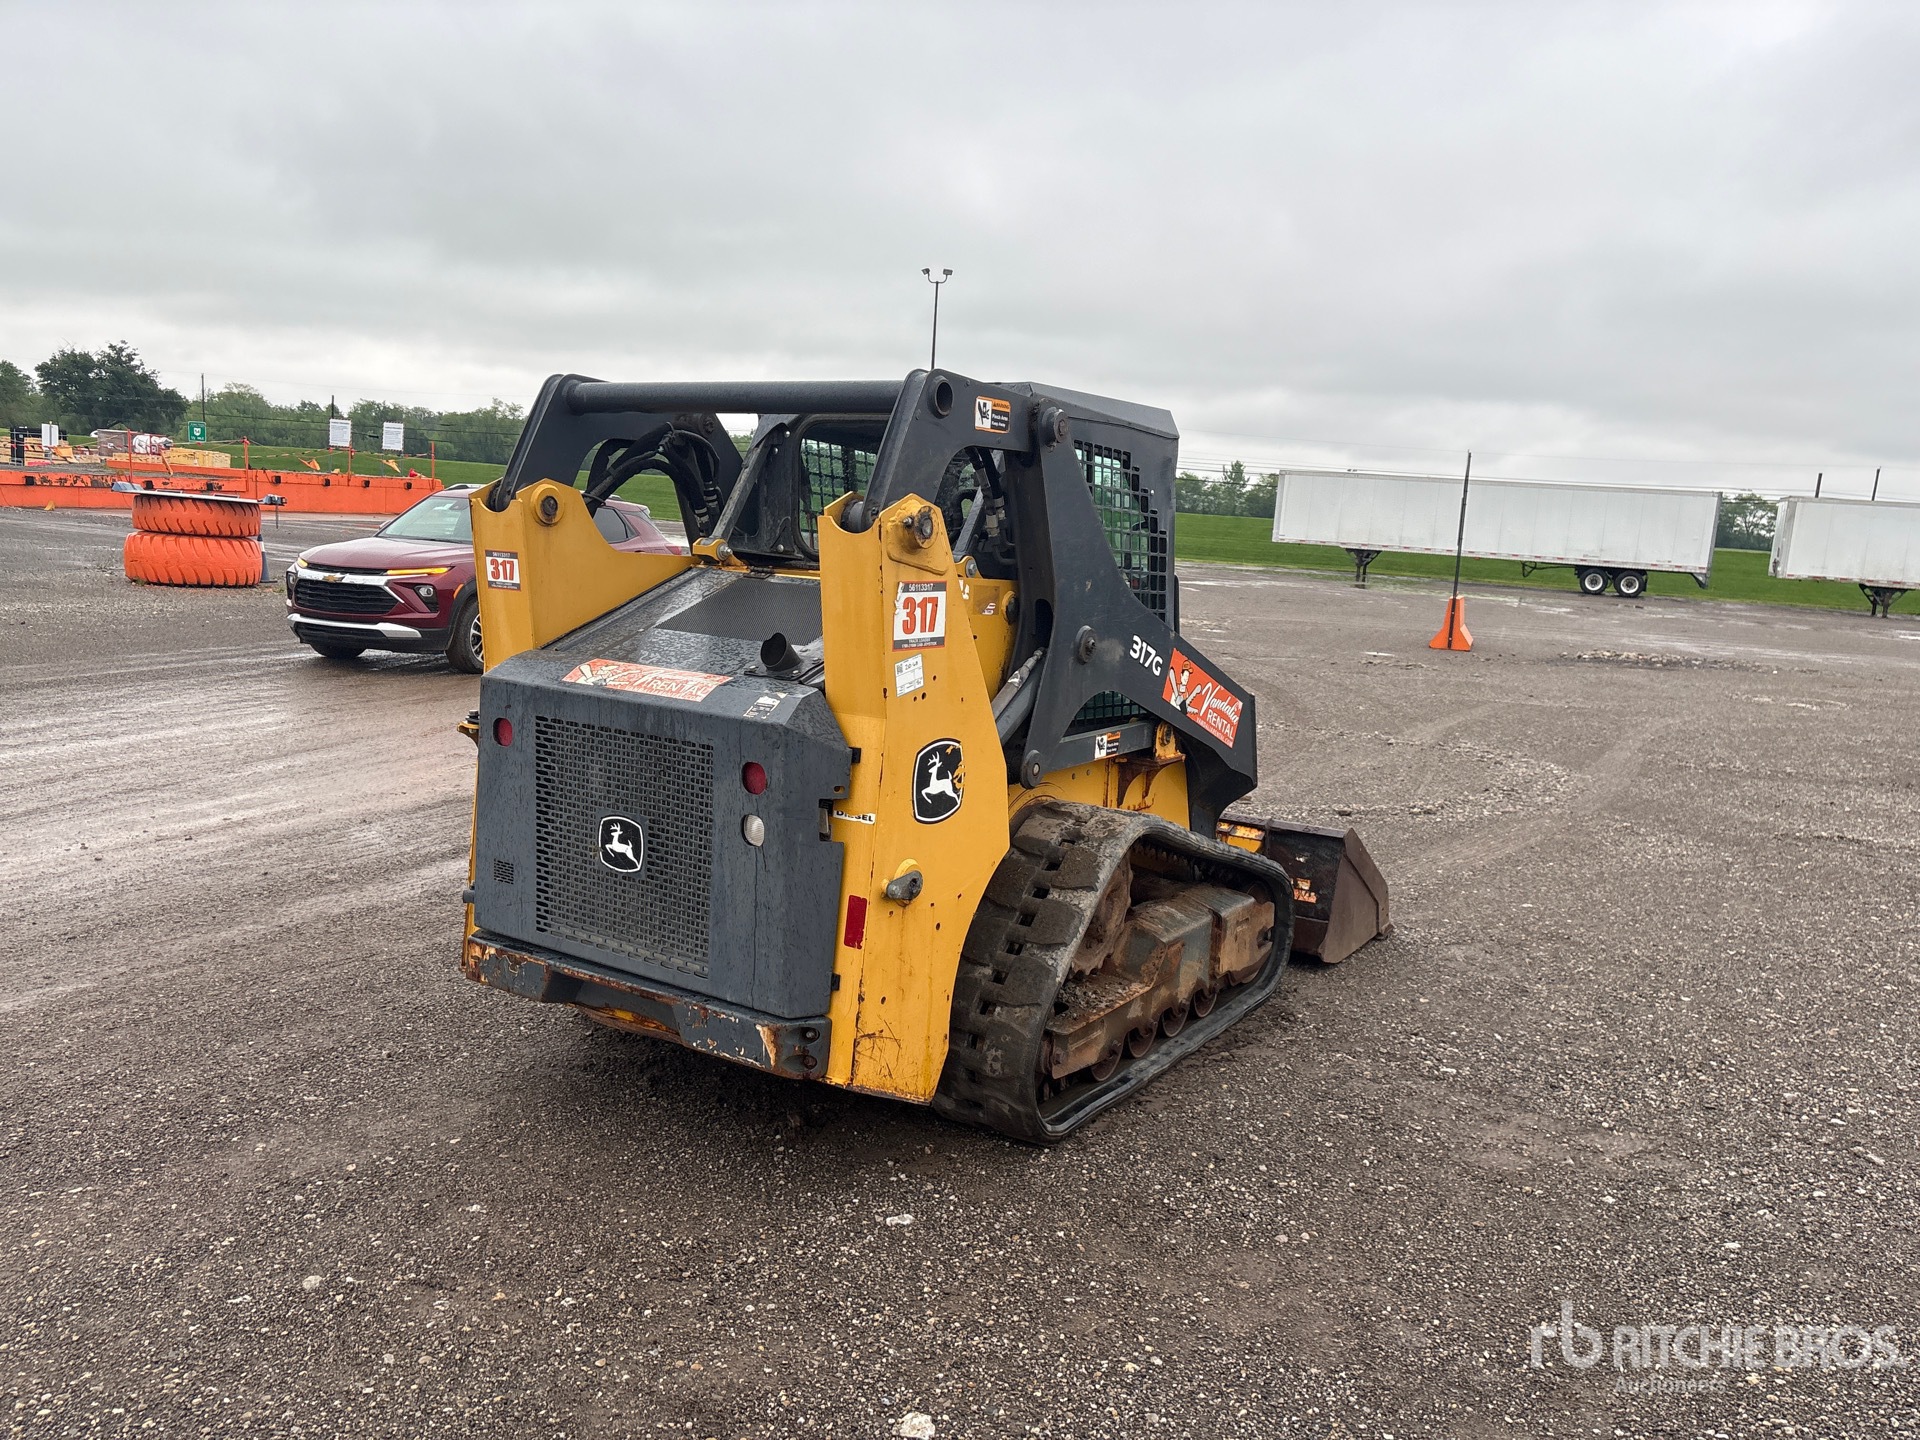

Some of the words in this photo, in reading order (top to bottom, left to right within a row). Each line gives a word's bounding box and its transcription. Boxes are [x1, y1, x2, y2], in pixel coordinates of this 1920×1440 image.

[490, 558, 514, 581] 317
[908, 583, 934, 592] 56113317
[902, 596, 938, 635] 317
[1129, 634, 1164, 677] 317G
[647, 679, 710, 697] RENTAL
[1200, 681, 1240, 725] Vandalia
[1206, 708, 1235, 740] RENTAL
